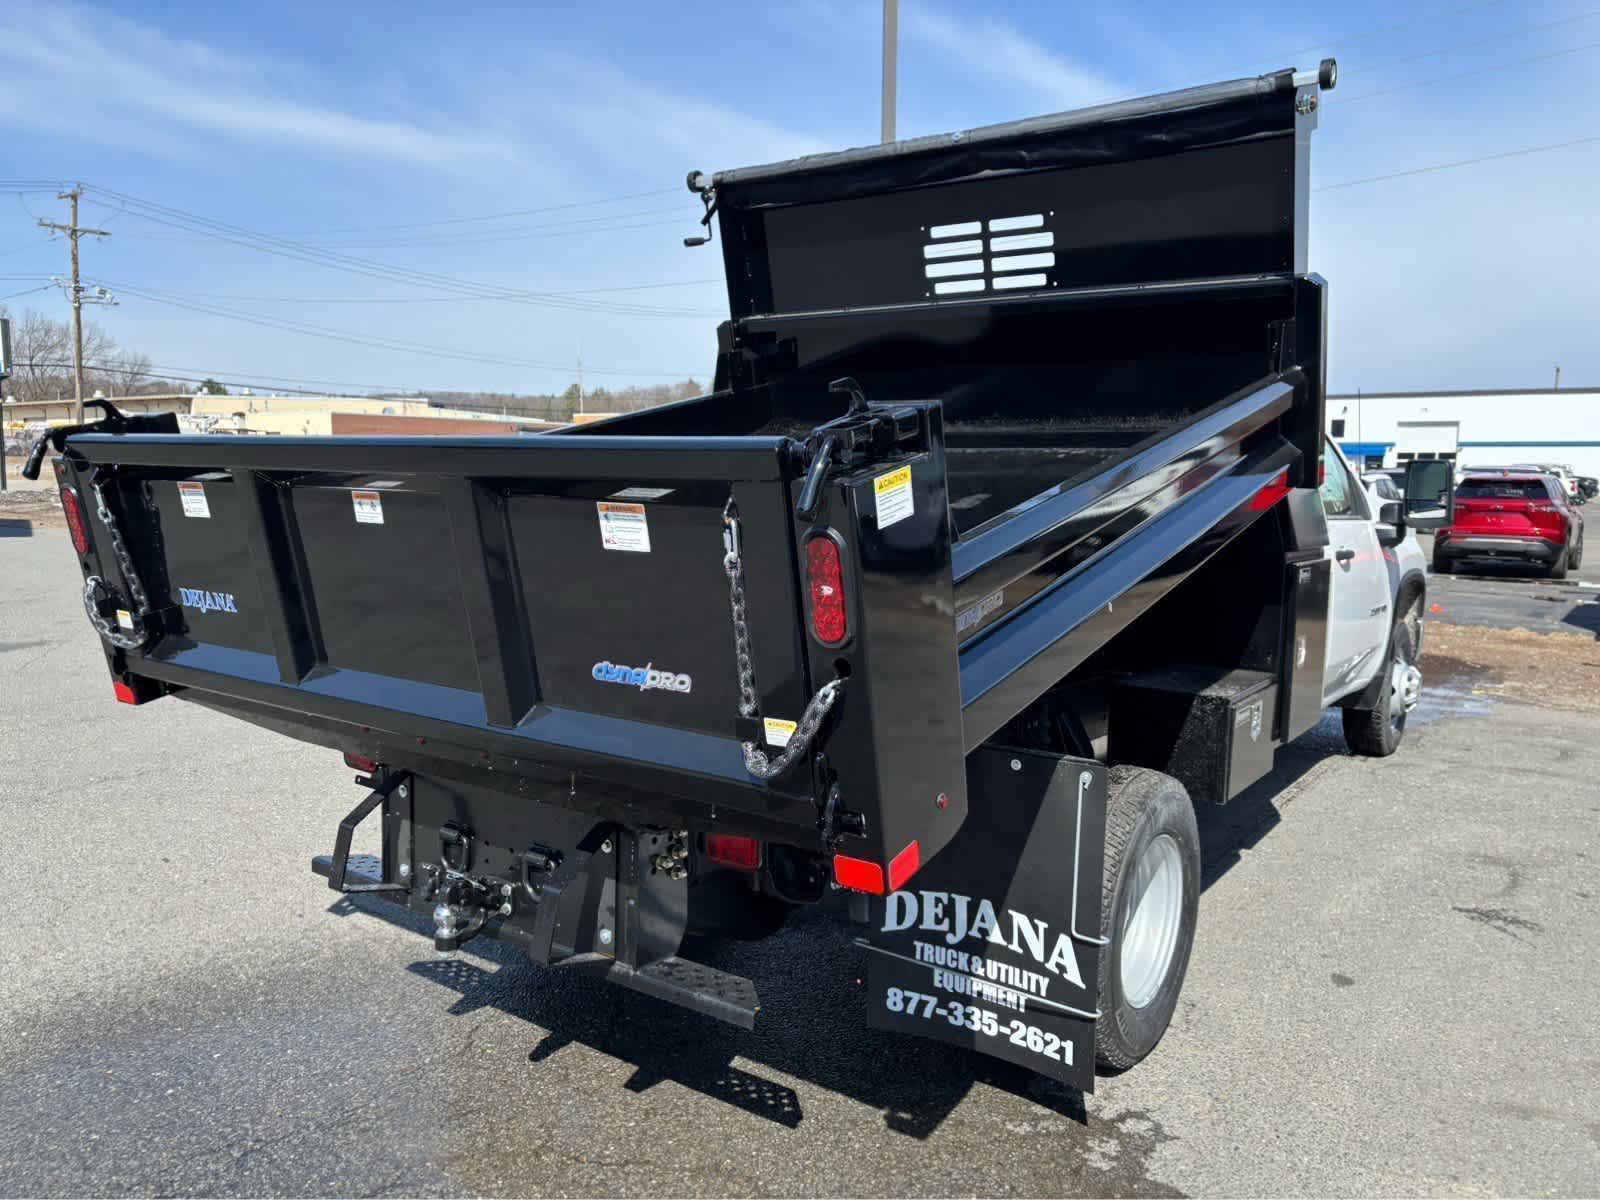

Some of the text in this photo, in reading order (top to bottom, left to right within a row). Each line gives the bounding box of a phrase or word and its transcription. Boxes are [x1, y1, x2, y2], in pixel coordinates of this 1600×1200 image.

[883, 473, 908, 487] CAUTION
[179, 588, 238, 613] DEJANA
[880, 890, 1086, 990] DEJANA
[913, 940, 970, 974] TRUCK
[986, 959, 1050, 997] UTILITY
[933, 967, 1028, 1013] EQUIPMENT
[886, 987, 1074, 1066] 877-335-2621
